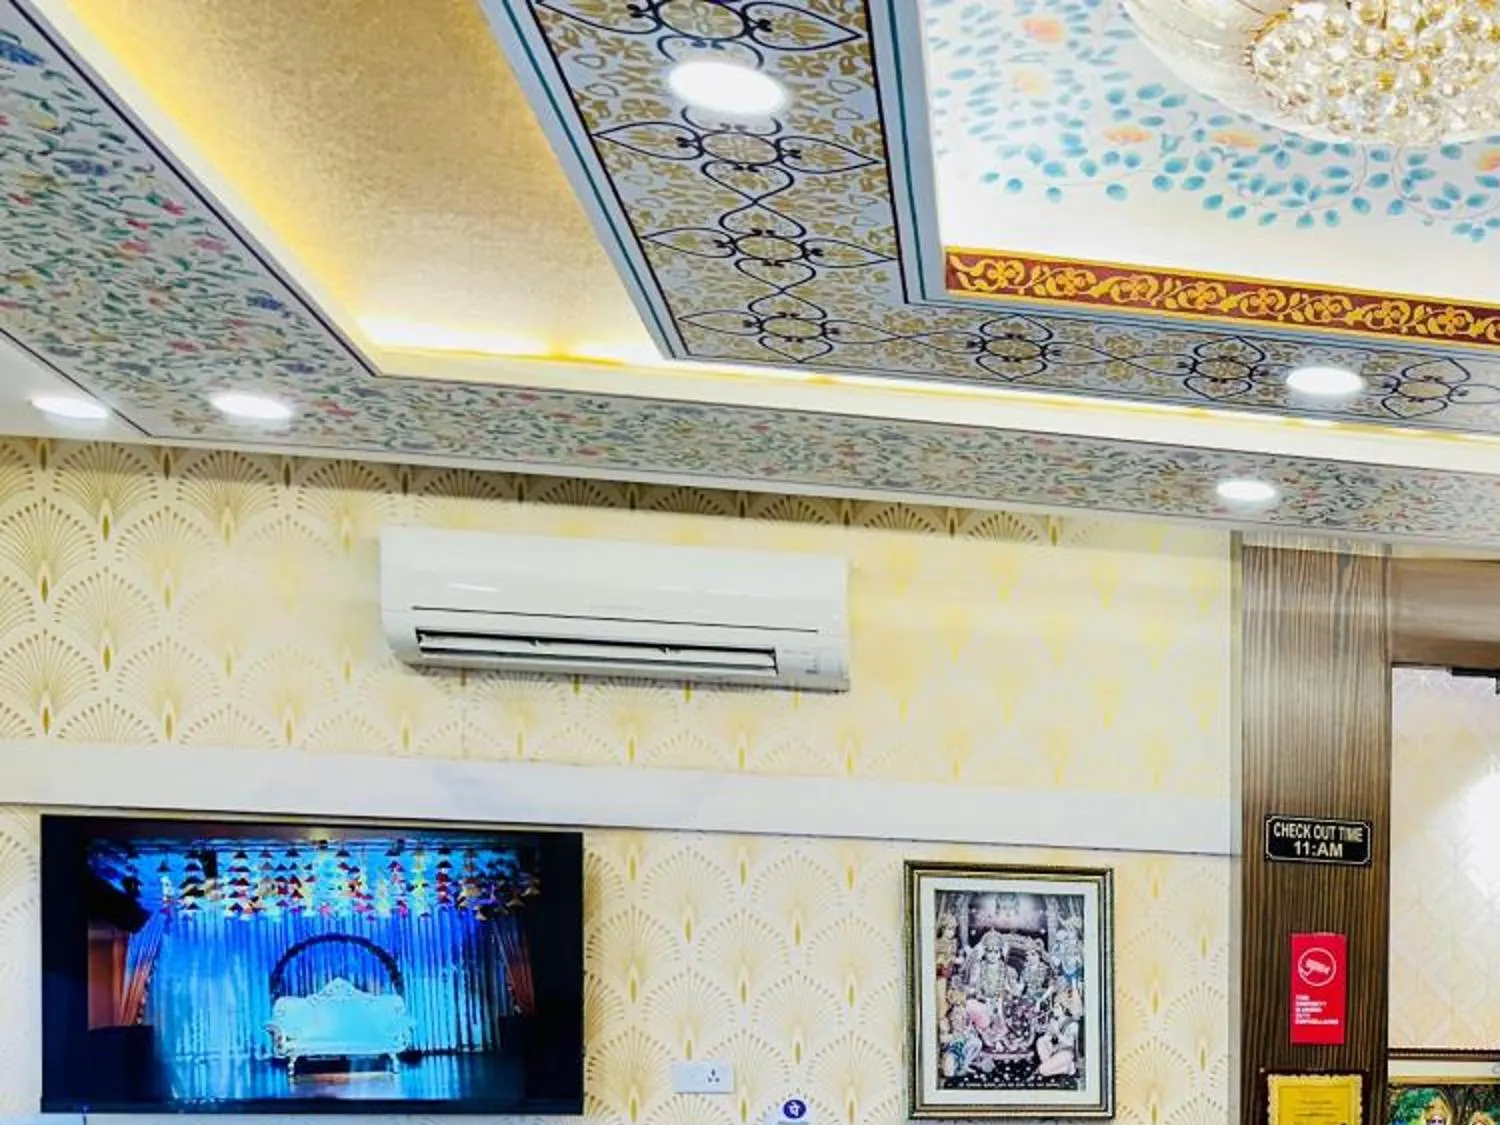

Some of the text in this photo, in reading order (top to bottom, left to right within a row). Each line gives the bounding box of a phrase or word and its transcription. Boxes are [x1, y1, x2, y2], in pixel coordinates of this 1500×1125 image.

[1273, 822, 1311, 839] CHECK
[1313, 824, 1336, 841] OUT
[1293, 840, 1343, 857] 11:AM
